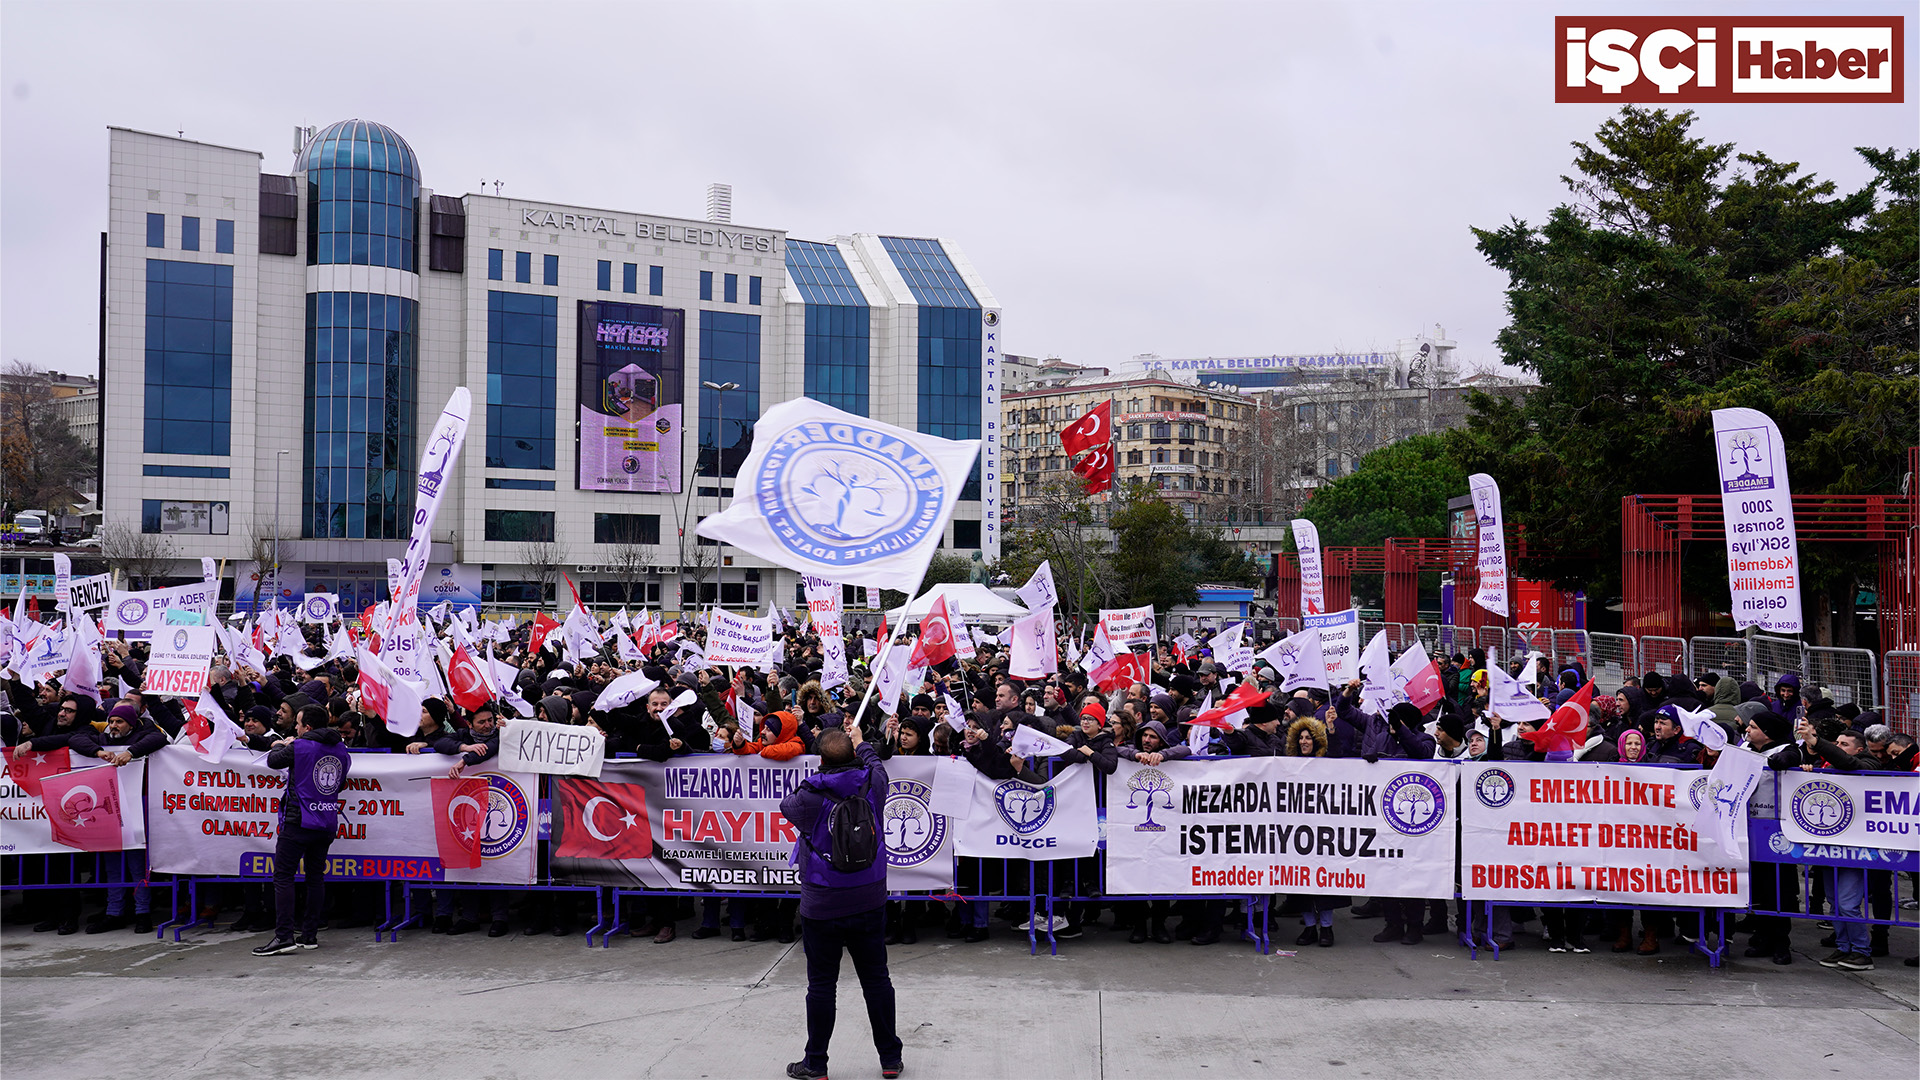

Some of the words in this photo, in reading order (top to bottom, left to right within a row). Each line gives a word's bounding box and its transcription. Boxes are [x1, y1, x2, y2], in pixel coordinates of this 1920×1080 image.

[521, 207, 626, 237] KARTAL
[636, 220, 778, 252] BELEDİYESİ
[987, 332, 995, 404] KARTAL
[1143, 361, 1167, 371] T.C.
[1172, 359, 1224, 370] KARTAL
[1227, 355, 1294, 368] BELEDİYE
[1299, 353, 1384, 368] BAŞKANLIĞI
[987, 421, 995, 544] BELEDİYESİ
[70, 576, 111, 608] DENİZLİ
[1326, 659, 1343, 673] ayır!
[146, 666, 207, 693] KAYSERİ
[518, 729, 596, 765] KAYSERİ
[183, 770, 195, 787] 8
[197, 768, 246, 788] EYLÜL
[664, 767, 744, 799] MEZARDA
[1384, 775, 1421, 802] EMADDER
[163, 789, 187, 815] İŞE
[188, 791, 268, 814] GİRMENİN
[503, 781, 527, 821] BURSA
[888, 781, 932, 803] ADDE
[1181, 781, 1272, 815] MEZARDA
[1529, 775, 1677, 809] EMEKLİLİKTE
[1795, 781, 1850, 804] EMADDER
[357, 799, 378, 816] 20
[379, 799, 405, 817] YIL
[201, 819, 274, 840] OLAMAZ,
[663, 809, 798, 843] HAYIR
[1507, 821, 1593, 848] ADALET
[1597, 821, 1699, 853] DERNEĞİ
[1865, 820, 1910, 835] BOLU
[995, 833, 1058, 850] DÜZCE
[1802, 843, 1873, 862] ZABITA
[662, 849, 722, 860] KADAMELİ
[725, 849, 788, 861] EMEKLİLİK
[896, 849, 929, 864] ADALET
[362, 858, 433, 879] BURSA
[680, 867, 759, 885] EMADER
[1191, 865, 1265, 887] Emadder
[1315, 866, 1367, 889] Grubu
[1471, 864, 1551, 889] BURSA
[1556, 861, 1577, 890] İL
[1580, 863, 1739, 895] TEMSİLCİLİĞİ
